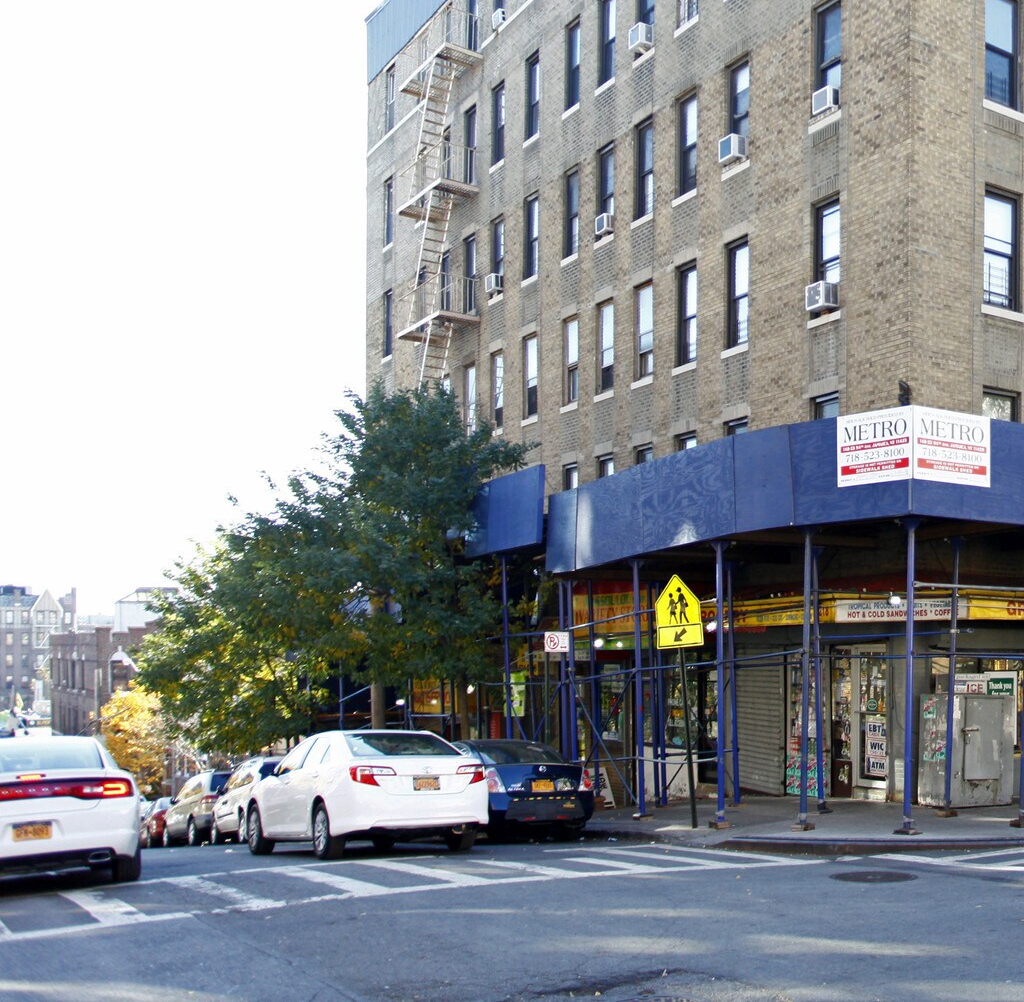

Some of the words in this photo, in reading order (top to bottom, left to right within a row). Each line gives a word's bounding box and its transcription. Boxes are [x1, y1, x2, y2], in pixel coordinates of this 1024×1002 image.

[844, 418, 907, 443] METRO
[920, 418, 984, 444] METRO
[856, 466, 880, 474] SIDEWALK
[868, 610, 884, 618] COLD
[886, 609, 928, 617] SANDWCHES
[966, 683, 983, 693] ICE
[989, 681, 1002, 690] Thank
[1003, 683, 1012, 691] you
[869, 724, 881, 733] EBT
[870, 741, 884, 751] WIC
[871, 761, 885, 769] ATM
